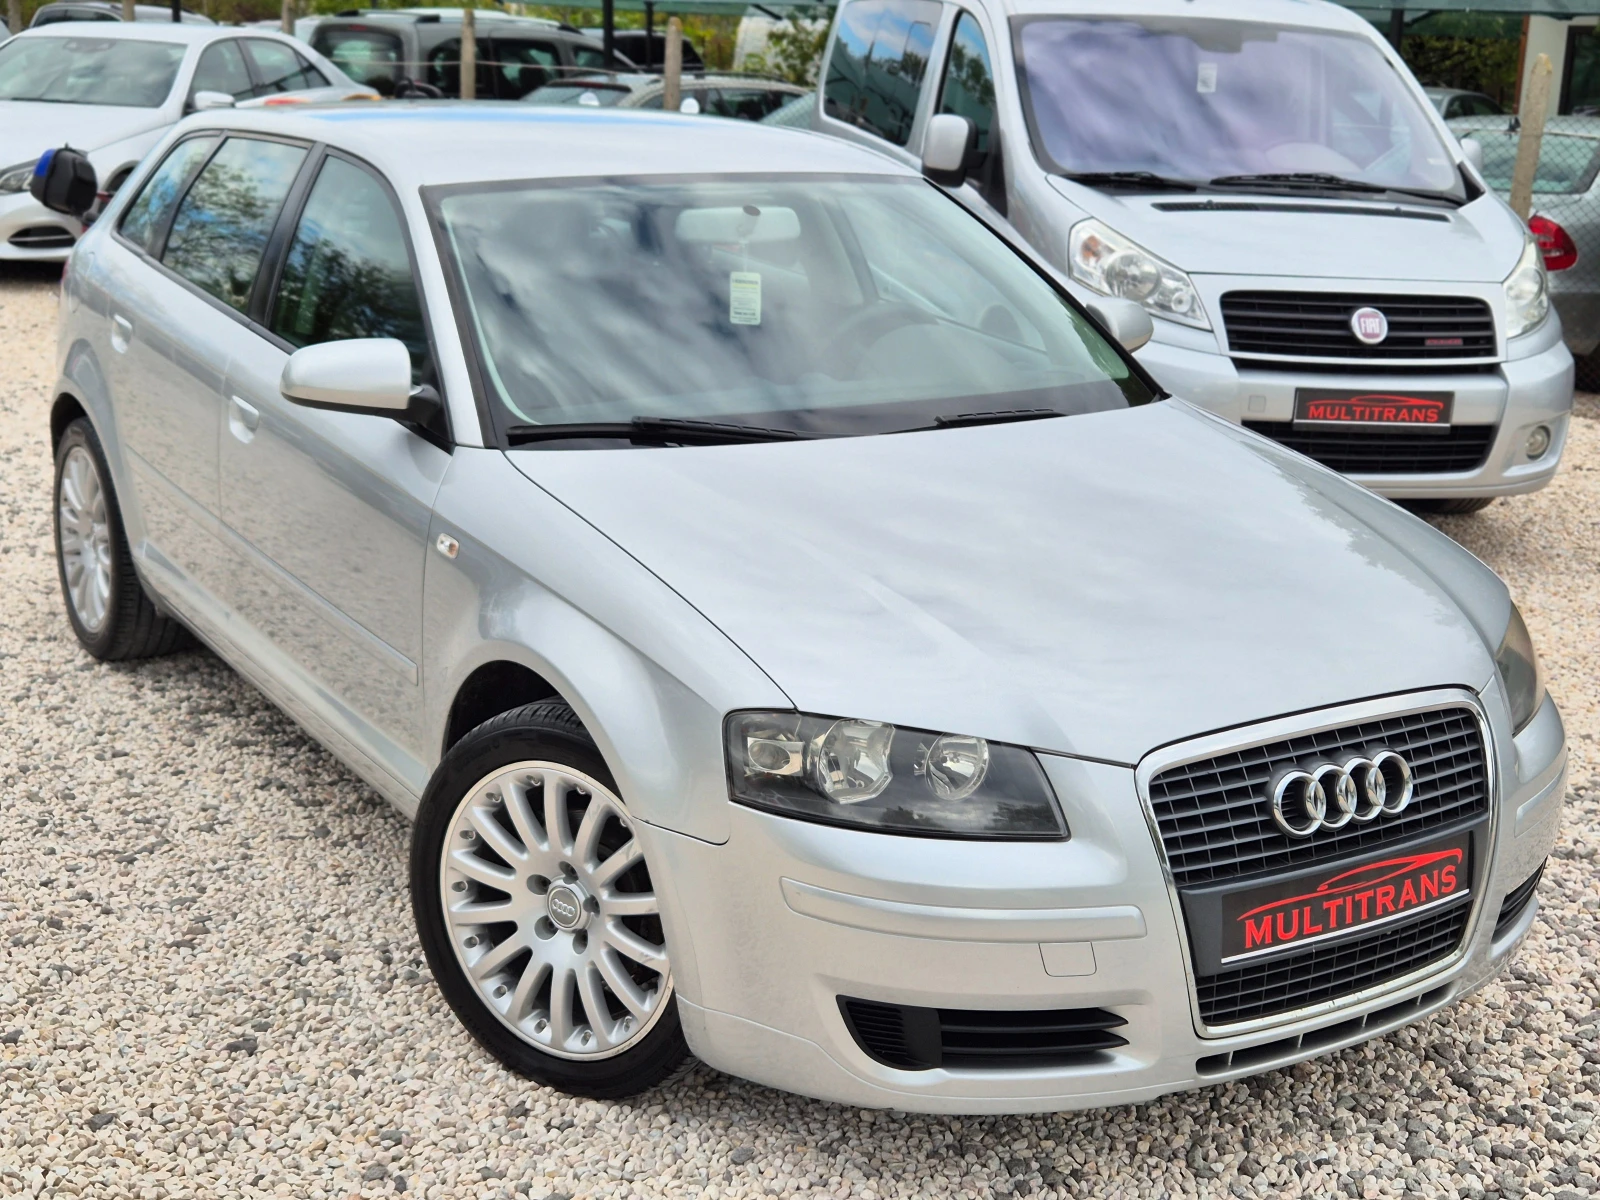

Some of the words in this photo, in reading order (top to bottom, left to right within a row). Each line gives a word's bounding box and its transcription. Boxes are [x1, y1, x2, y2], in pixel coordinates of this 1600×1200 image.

[1360, 317, 1380, 334] FIAT
[1308, 405, 1438, 422] MULTITRANS
[1245, 865, 1457, 947] MULTITRANS
